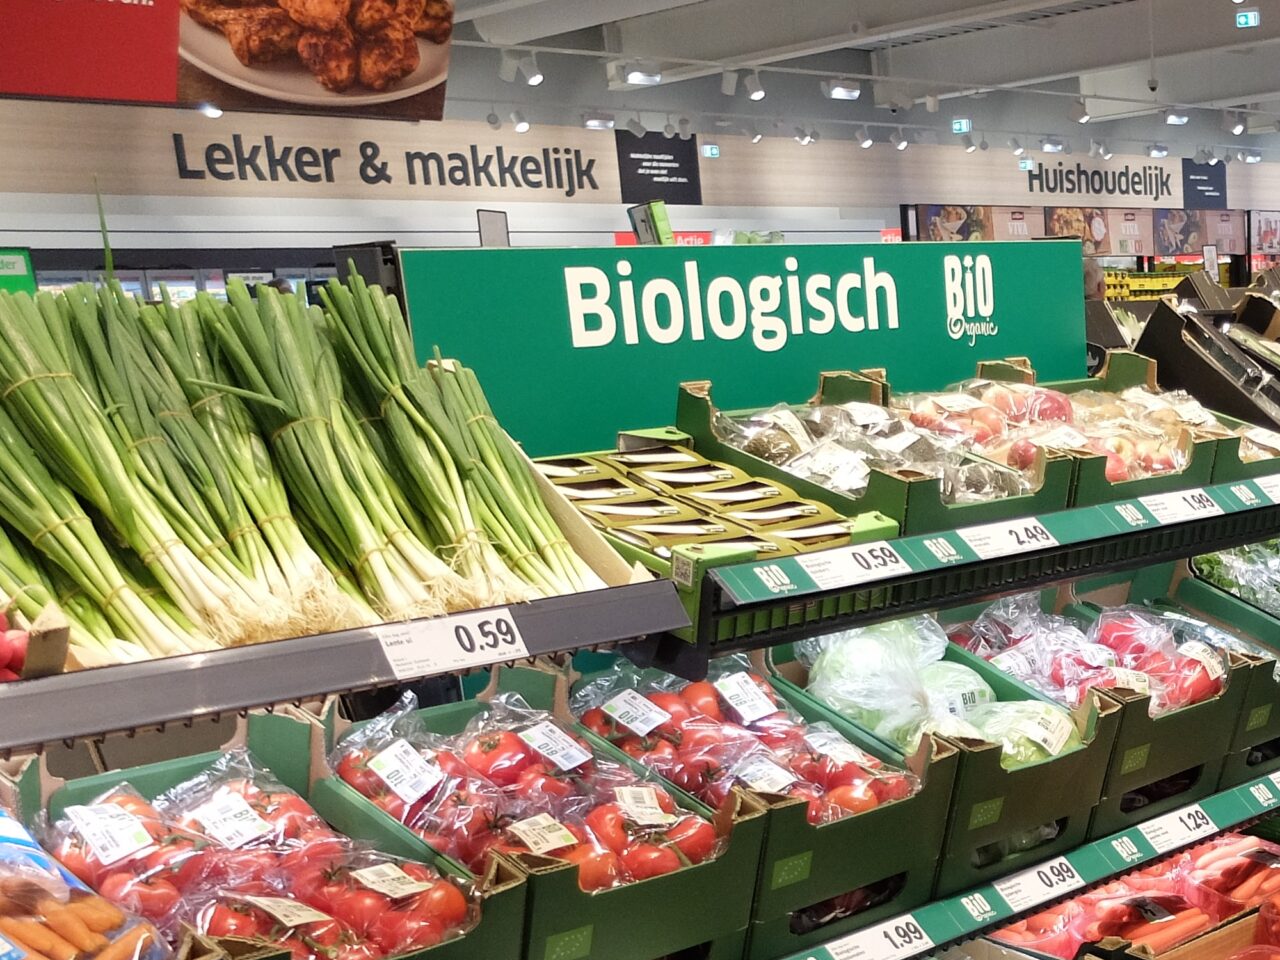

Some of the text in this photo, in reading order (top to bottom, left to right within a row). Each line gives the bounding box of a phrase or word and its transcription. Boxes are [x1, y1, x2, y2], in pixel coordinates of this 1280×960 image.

[172, 132, 341, 182] Lekker
[358, 140, 392, 184] &
[405, 145, 599, 197] makkelijk
[1028, 160, 1171, 201] Huishoudelijk
[564, 256, 899, 352] Biologisch
[1008, 525, 1050, 546] 2.49
[852, 546, 900, 571] 0.59
[454, 617, 517, 653] 0.59
[1178, 808, 1211, 832] 1.29
[1036, 861, 1076, 889] 0.99
[883, 921, 924, 950] 1.99
